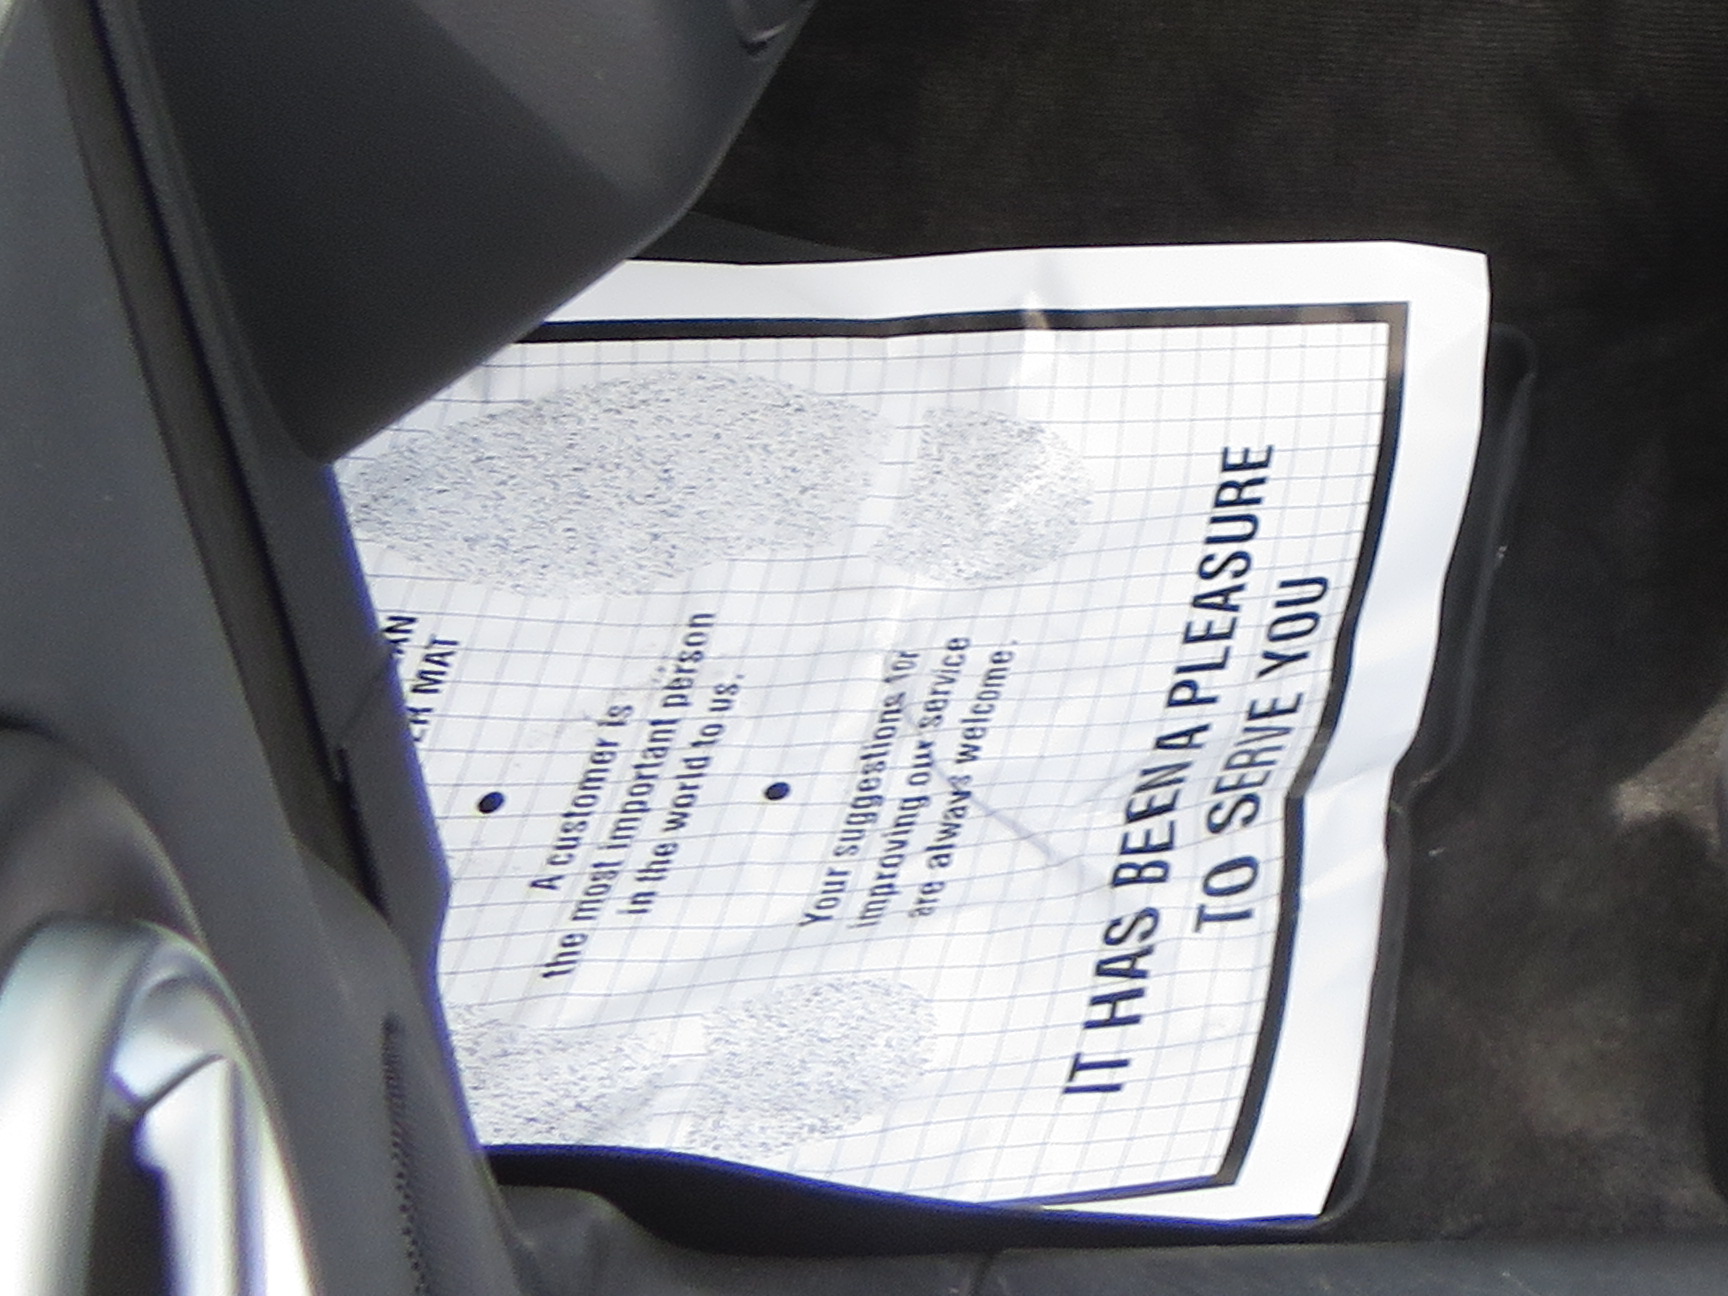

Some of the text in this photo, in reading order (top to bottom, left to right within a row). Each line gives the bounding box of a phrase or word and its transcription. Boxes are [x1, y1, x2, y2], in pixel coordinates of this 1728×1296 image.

[410, 633, 459, 693] MAT
[528, 703, 633, 890] A customer is
[541, 612, 715, 978] the most important person
[617, 673, 743, 914] in the world to us.
[847, 636, 970, 928] improving our service
[907, 880, 945, 917] are
[954, 639, 1018, 763] welcome.
[1062, 443, 1273, 1093] IT HAS BEEN A PLEASURE
[1193, 575, 1330, 932] TO SERVE YOU
[797, 866, 851, 926] Your
[832, 691, 906, 856] suggestions
